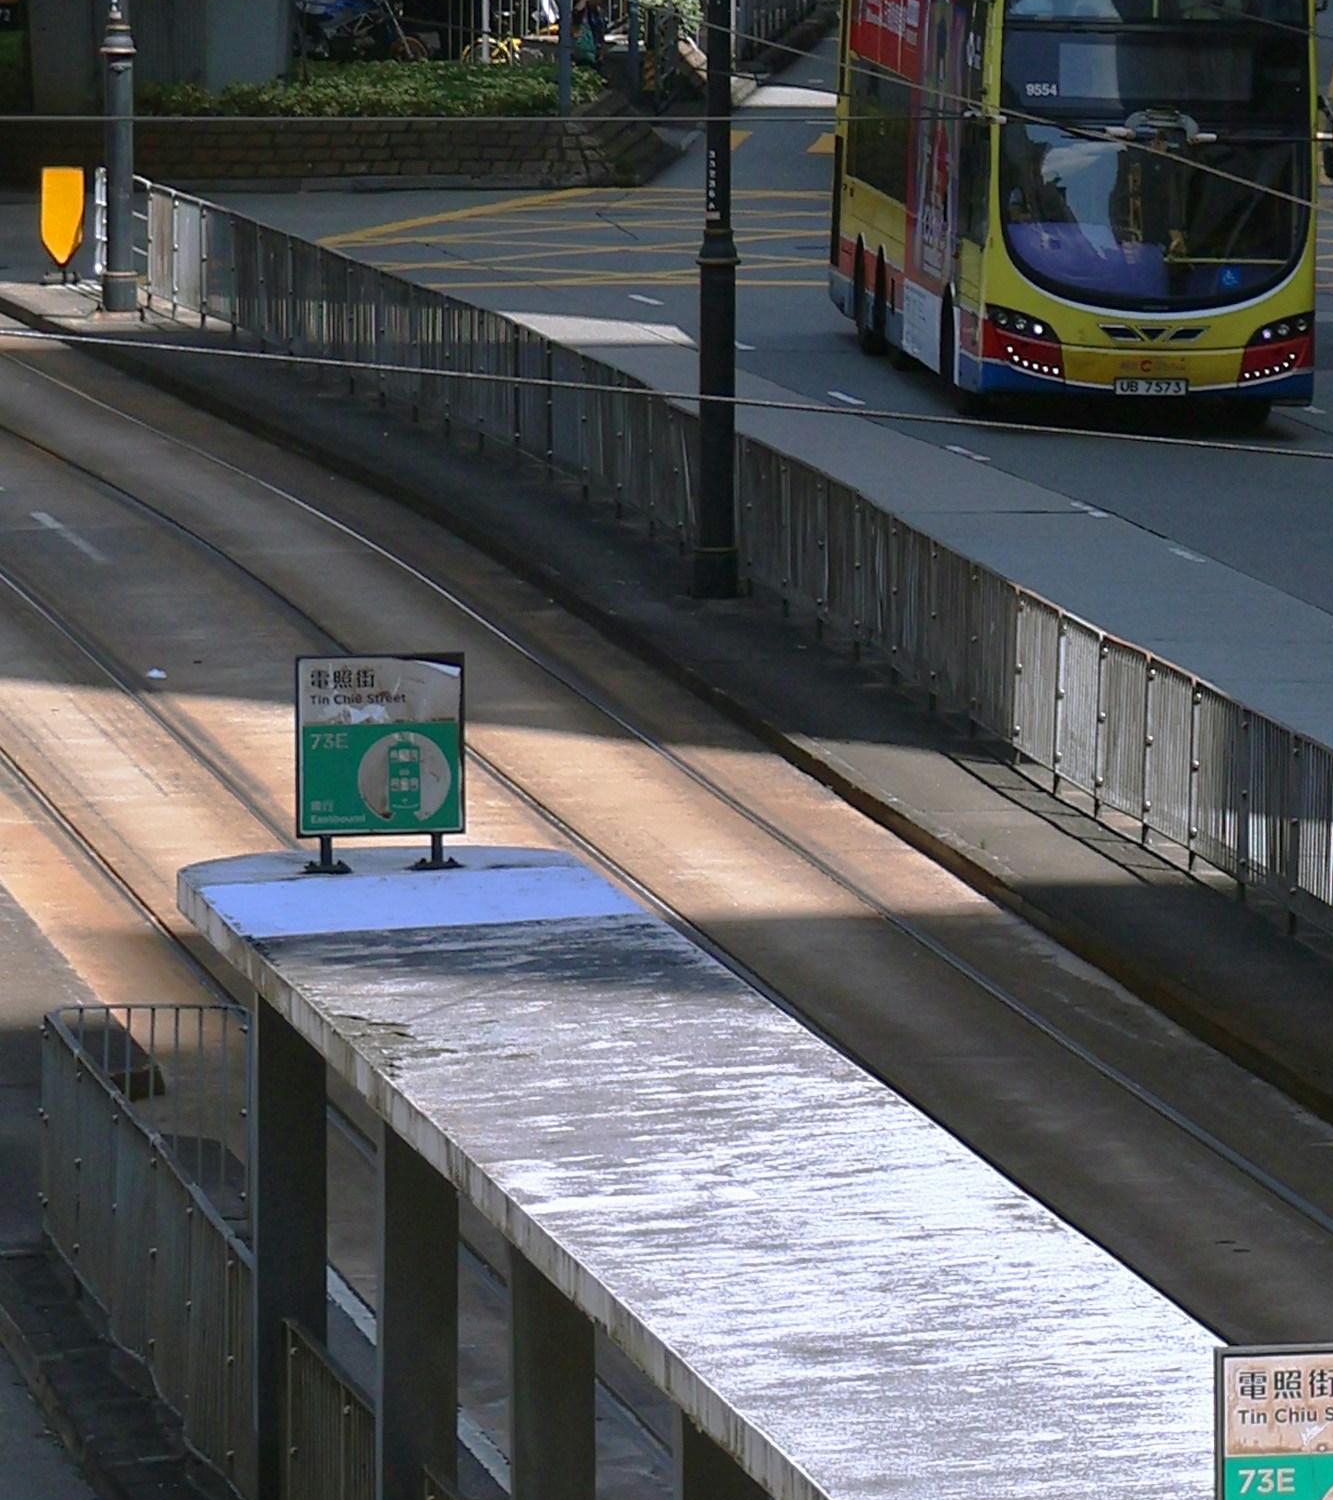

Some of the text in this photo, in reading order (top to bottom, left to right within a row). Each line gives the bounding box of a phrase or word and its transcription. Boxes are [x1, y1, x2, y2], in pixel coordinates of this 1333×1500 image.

[1025, 82, 1058, 97] 9554
[1119, 380, 1182, 393] UB 7573
[310, 668, 375, 689] 電照街
[310, 695, 330, 705] Tin
[367, 692, 406, 704] Street
[310, 732, 349, 750] 73E
[1238, 1408, 1267, 1425] Tin
[1274, 1406, 1318, 1424] Chiu
[1237, 1467, 1296, 1496] 73E
